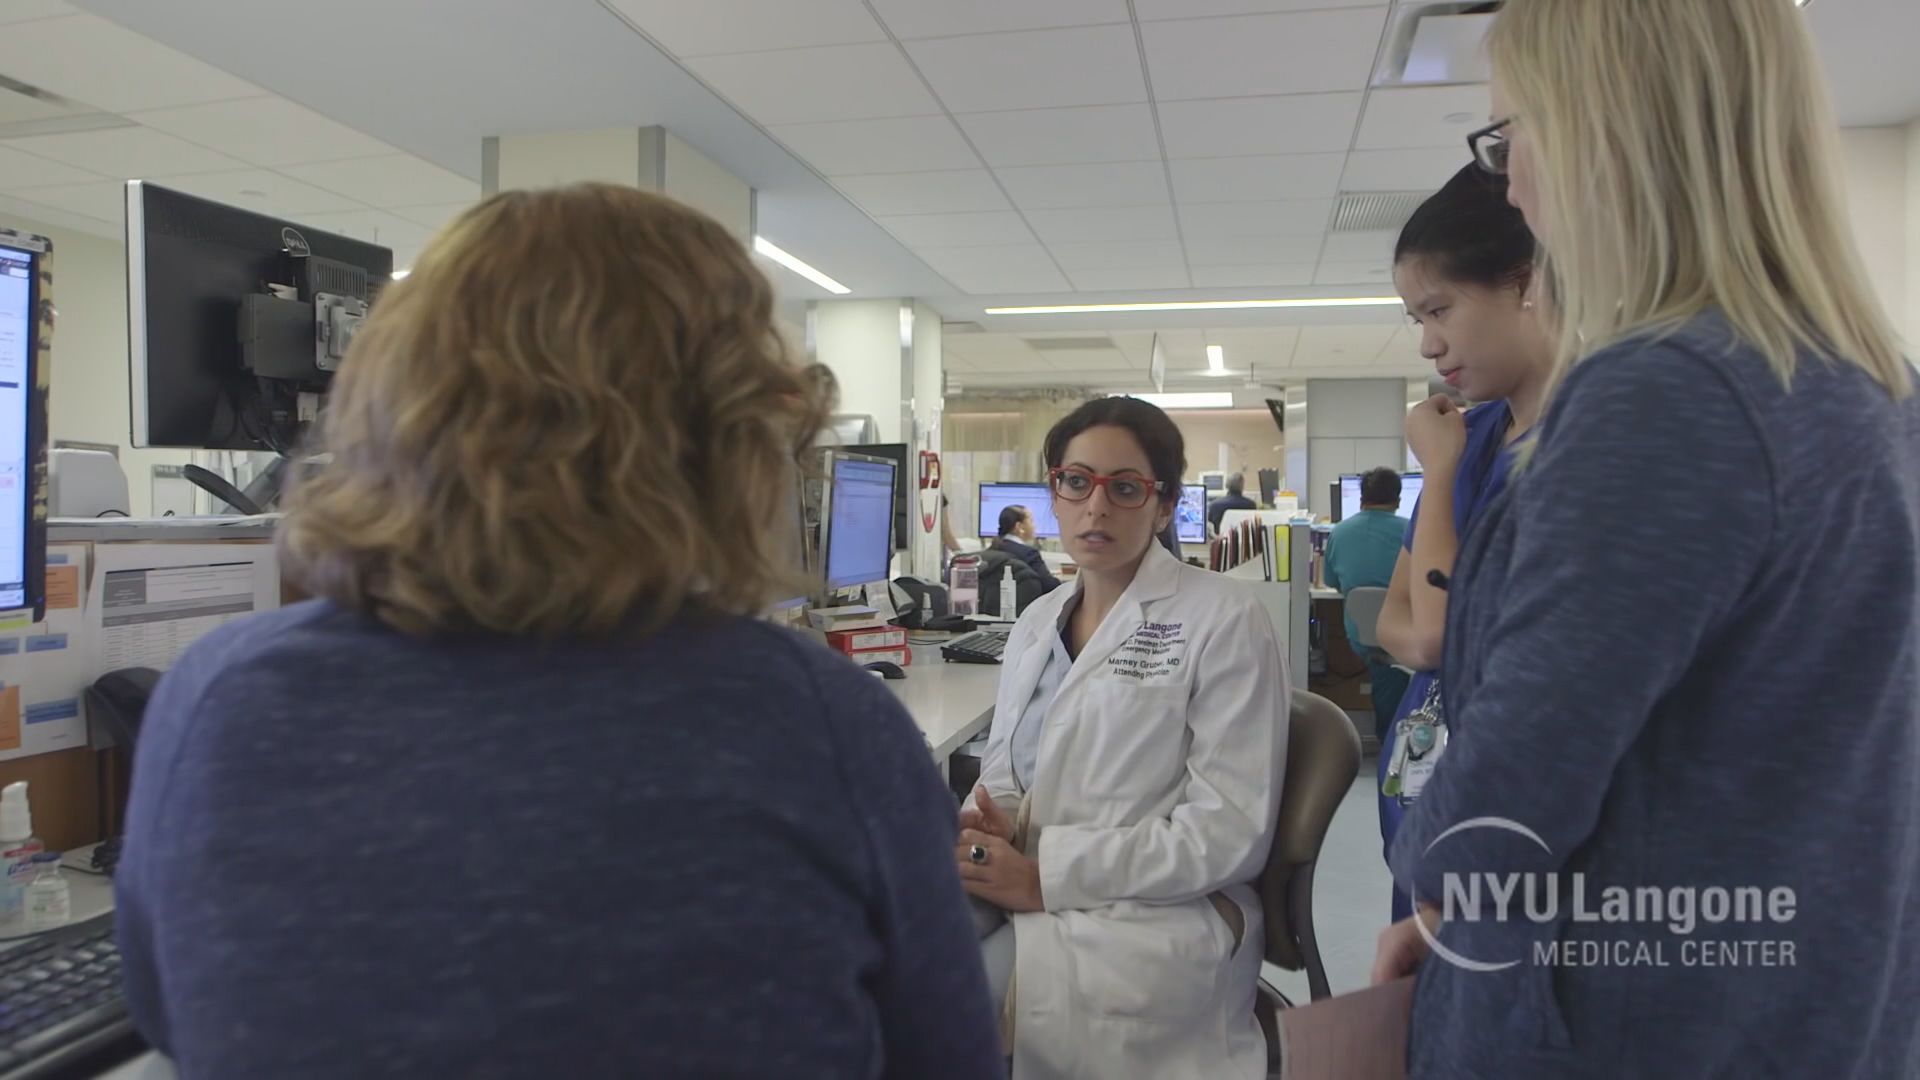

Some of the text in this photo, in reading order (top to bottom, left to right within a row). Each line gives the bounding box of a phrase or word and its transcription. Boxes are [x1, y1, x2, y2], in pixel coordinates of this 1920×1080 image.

[1143, 620, 1182, 634] Langone
[1109, 658, 1138, 668] Marney
[1167, 658, 1180, 666] MD
[1113, 668, 1144, 679] Attending
